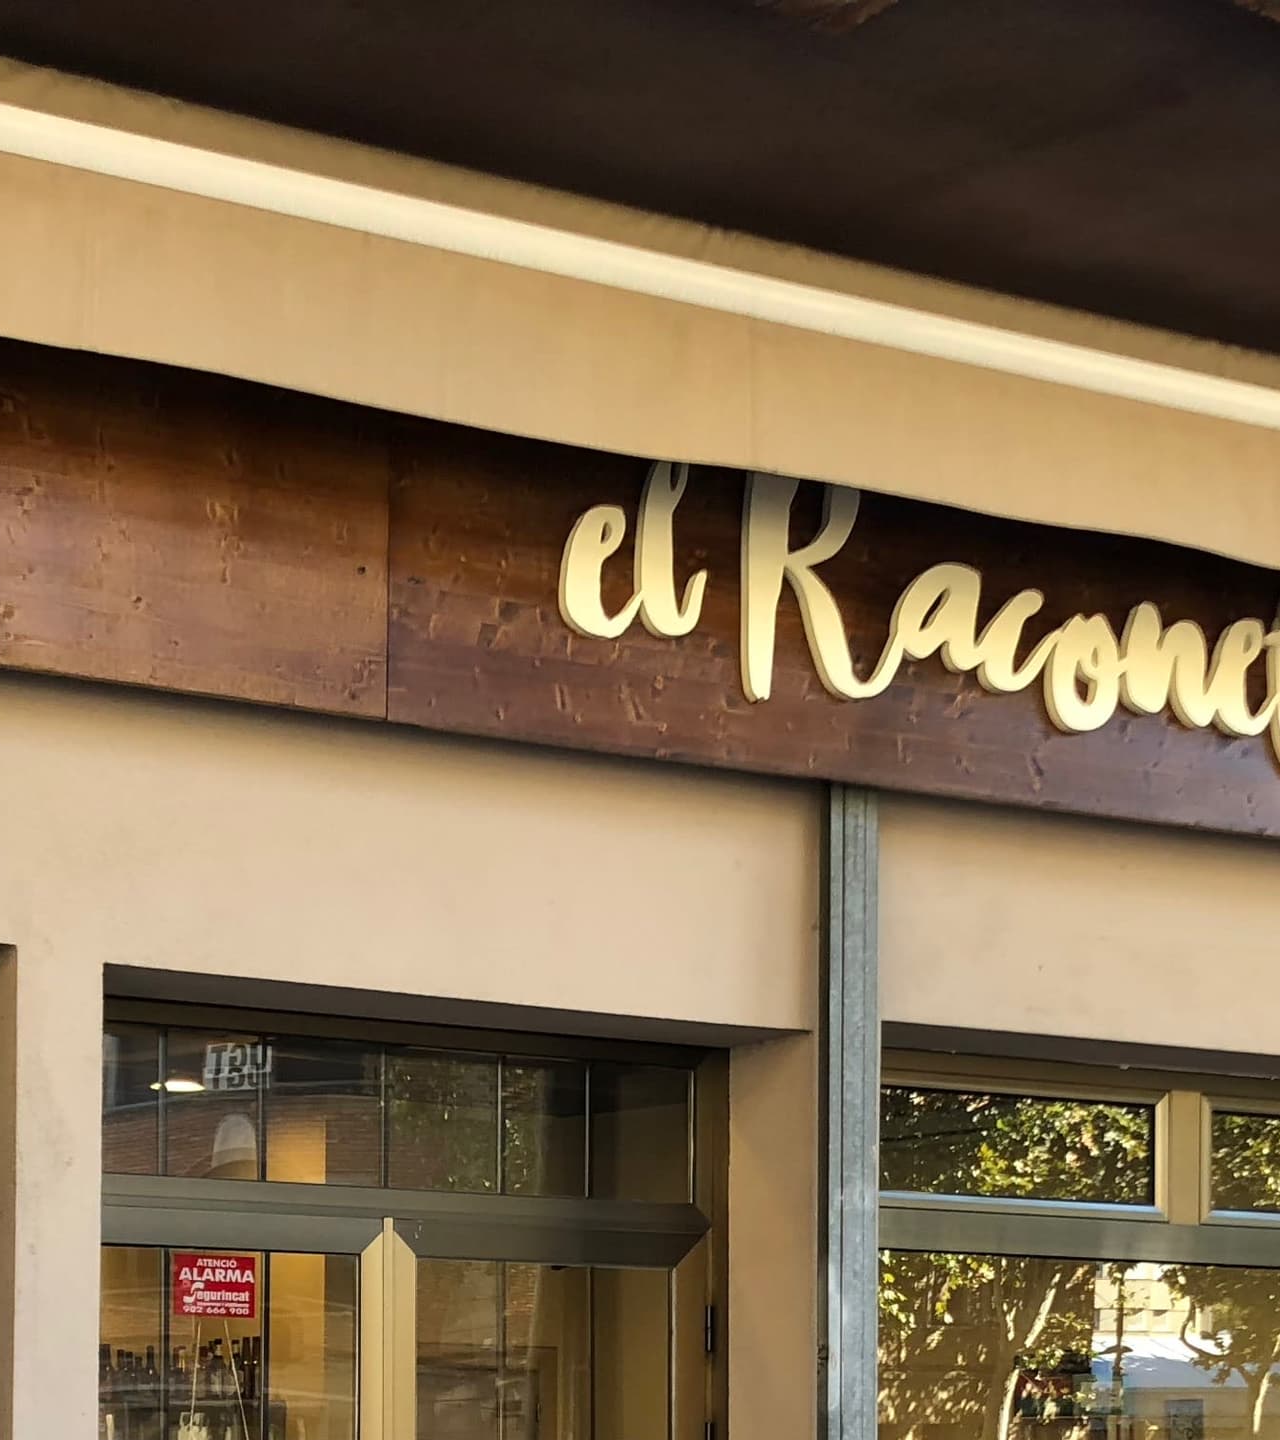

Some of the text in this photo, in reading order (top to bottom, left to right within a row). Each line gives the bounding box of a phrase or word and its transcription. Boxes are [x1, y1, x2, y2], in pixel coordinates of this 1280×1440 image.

[559, 462, 708, 640] el
[196, 1257, 237, 1268] ATENCIÓ
[179, 1267, 255, 1283] ALARMA
[183, 1282, 250, 1303] Segurincat
[183, 1305, 203, 1313] 902
[229, 1307, 249, 1315] 900
